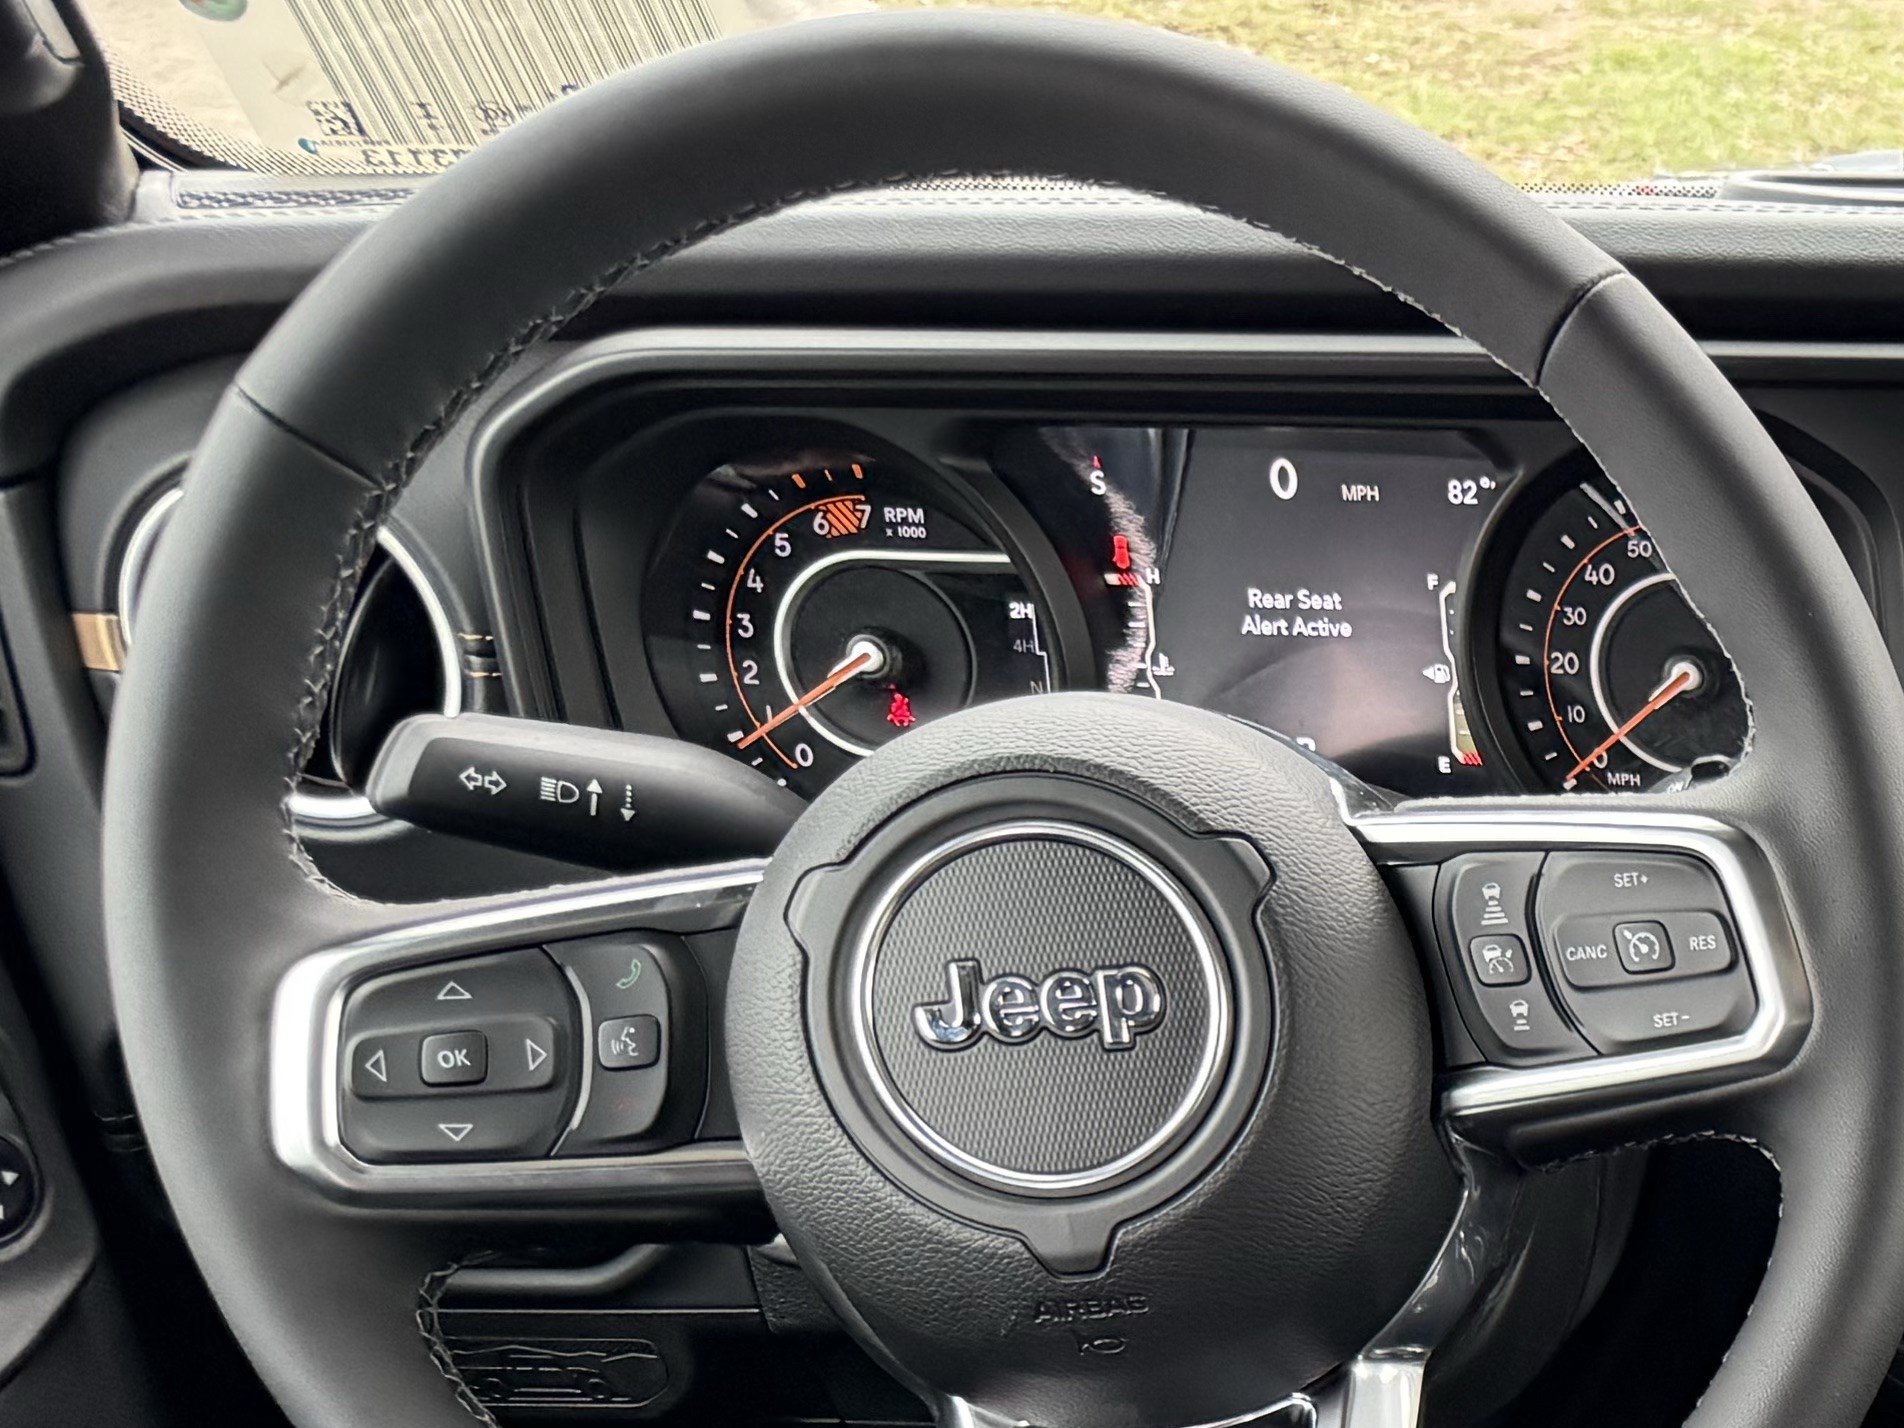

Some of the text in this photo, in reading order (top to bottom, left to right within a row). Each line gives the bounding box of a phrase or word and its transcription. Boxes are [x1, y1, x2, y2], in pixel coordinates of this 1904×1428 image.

[1090, 469, 1107, 495] S
[1269, 456, 1381, 503] 0 MPH
[812, 503, 926, 536] 6 7 RPM
[897, 526, 927, 539] 1000
[772, 533, 792, 558] 5
[1626, 537, 1653, 559] 50
[746, 568, 764, 594] 4
[1147, 568, 1161, 584] H
[1426, 574, 1438, 590] F
[1584, 562, 1616, 587] 40
[1246, 588, 1343, 611] Rear Seat
[1008, 603, 1034, 621] 2H
[1562, 605, 1587, 626] 30
[736, 613, 755, 639] 3
[1241, 615, 1353, 639] Alert Active
[741, 659, 760, 686] 2
[1550, 651, 1581, 675] 20
[1566, 704, 1586, 724] 10
[794, 742, 814, 767] 0
[1438, 756, 1451, 774] E
[1606, 771, 1641, 787] MPH
[1566, 944, 1608, 961] CANC
[1688, 934, 1717, 952] RES
[912, 956, 1168, 1053] Jeep
[436, 1047, 471, 1070] OK
